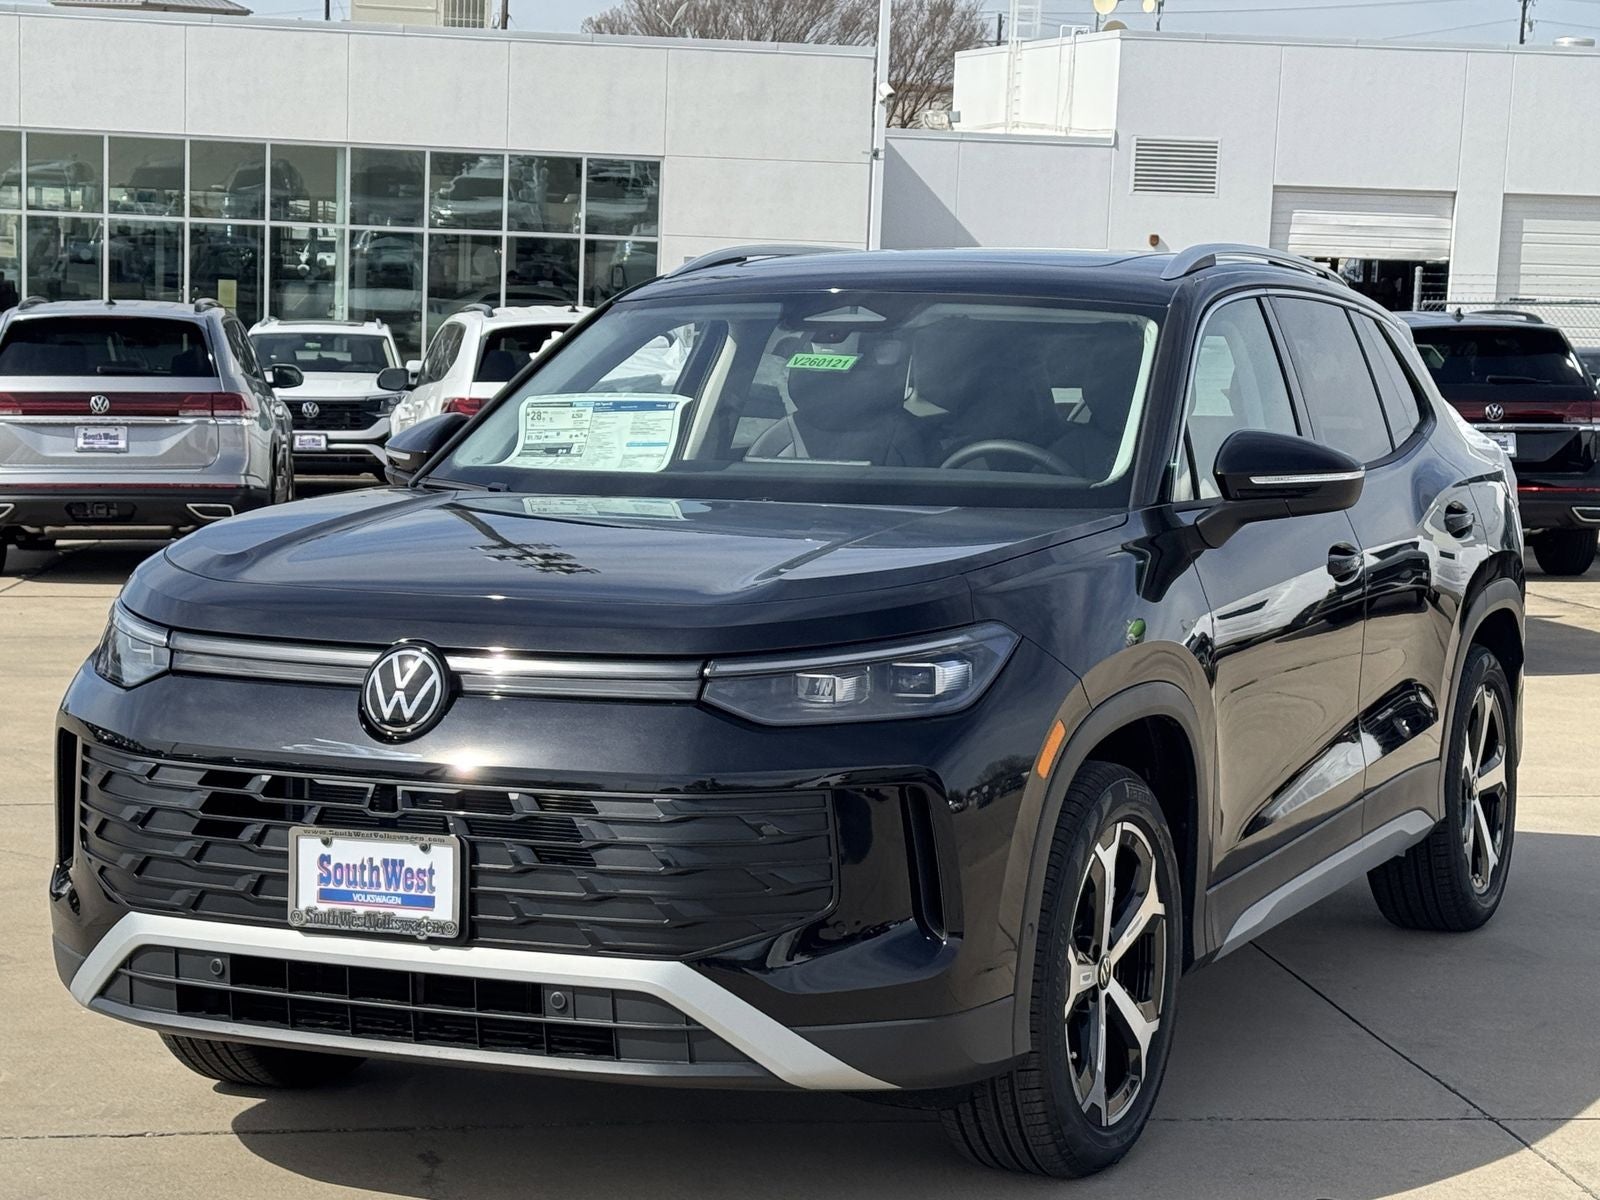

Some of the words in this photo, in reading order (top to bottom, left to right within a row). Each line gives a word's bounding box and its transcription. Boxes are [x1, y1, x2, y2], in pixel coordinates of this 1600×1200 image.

[793, 356, 851, 368] V260121
[368, 650, 441, 727] VW
[317, 853, 436, 893] SouthWest
[352, 893, 402, 905] VOLKSWAGEN
